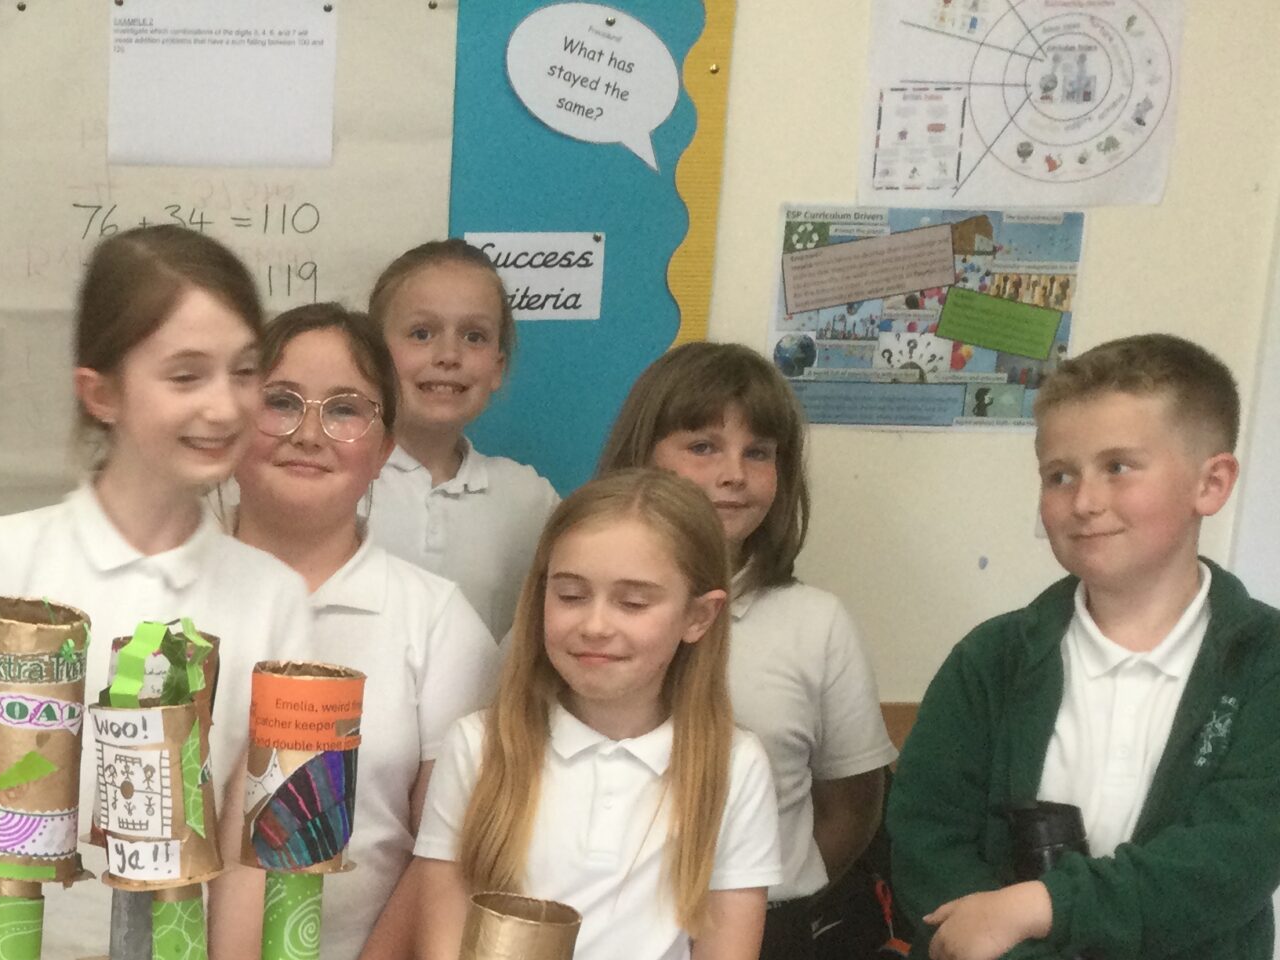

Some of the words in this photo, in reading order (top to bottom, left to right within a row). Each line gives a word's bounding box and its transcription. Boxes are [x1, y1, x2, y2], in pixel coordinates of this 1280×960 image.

[563, 35, 605, 63] What
[608, 51, 635, 74] has
[547, 65, 601, 92] stayed
[605, 81, 630, 102] the
[556, 97, 604, 121] same?
[72, 204, 119, 240] 76
[164, 204, 214, 232] 34
[804, 211, 852, 221] Curriculum
[854, 212, 885, 222] Drivers
[269, 261, 318, 303] 119
[506, 286, 582, 311] iteria
[272, 738, 313, 751] double
